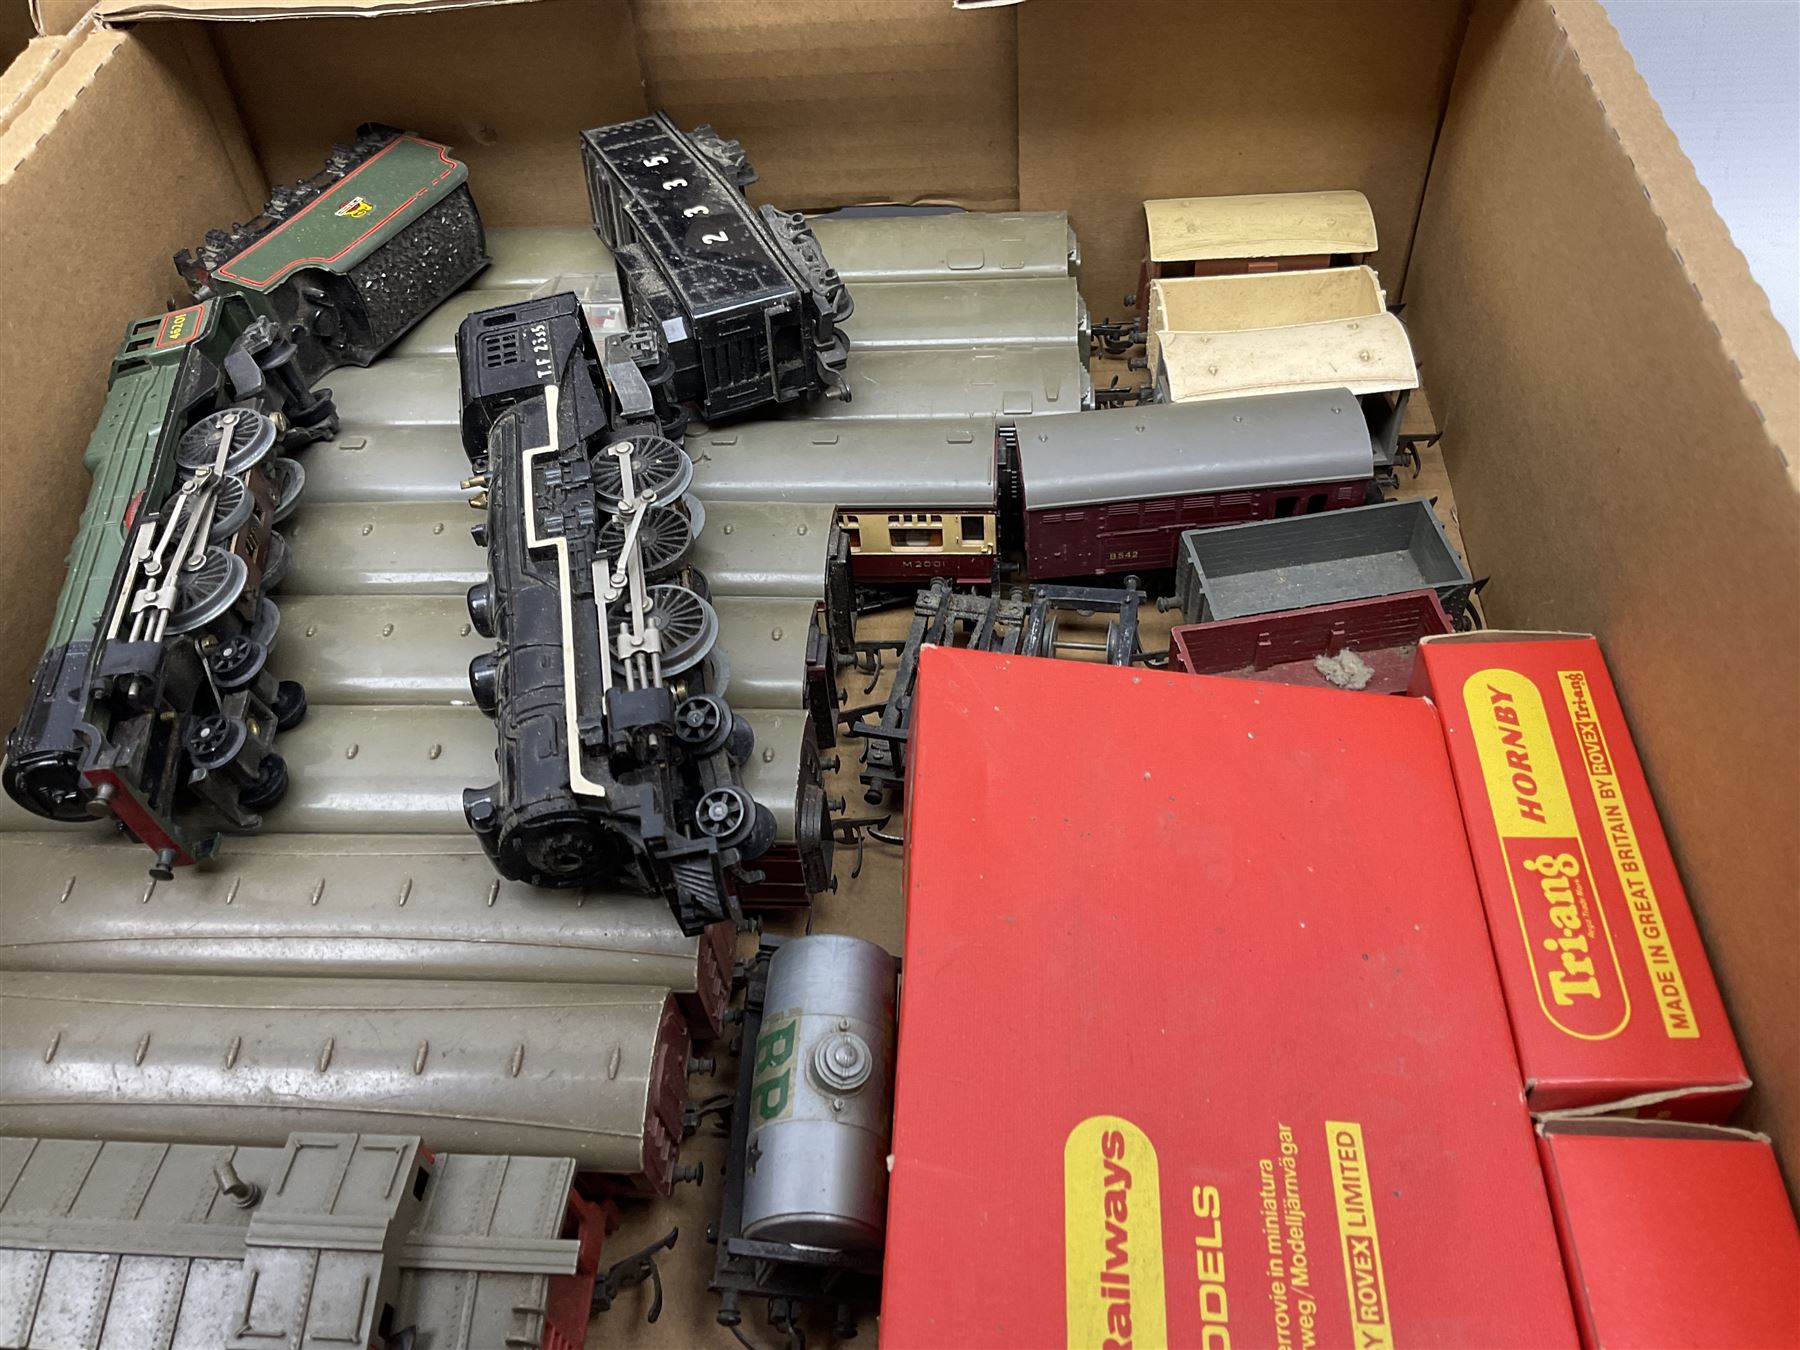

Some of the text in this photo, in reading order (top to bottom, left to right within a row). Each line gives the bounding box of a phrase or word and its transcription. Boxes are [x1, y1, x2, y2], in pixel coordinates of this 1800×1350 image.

[1486, 683, 1547, 825] HORNBY
[1581, 724, 1608, 774] ROVEX
[1599, 779, 1617, 800] BY
[1603, 805, 1640, 873] BRITAIN
[1626, 878, 1661, 940] GREAT
[1648, 945, 1670, 965] IN
[1655, 970, 1690, 1031] MADE
[753, 1019, 797, 1120] BP
[1258, 1158, 1282, 1256] miniatura
[1335, 1130, 1367, 1228] LIMITED
[1266, 1263, 1284, 1278] in
[1350, 1239, 1380, 1322] ROVEX
